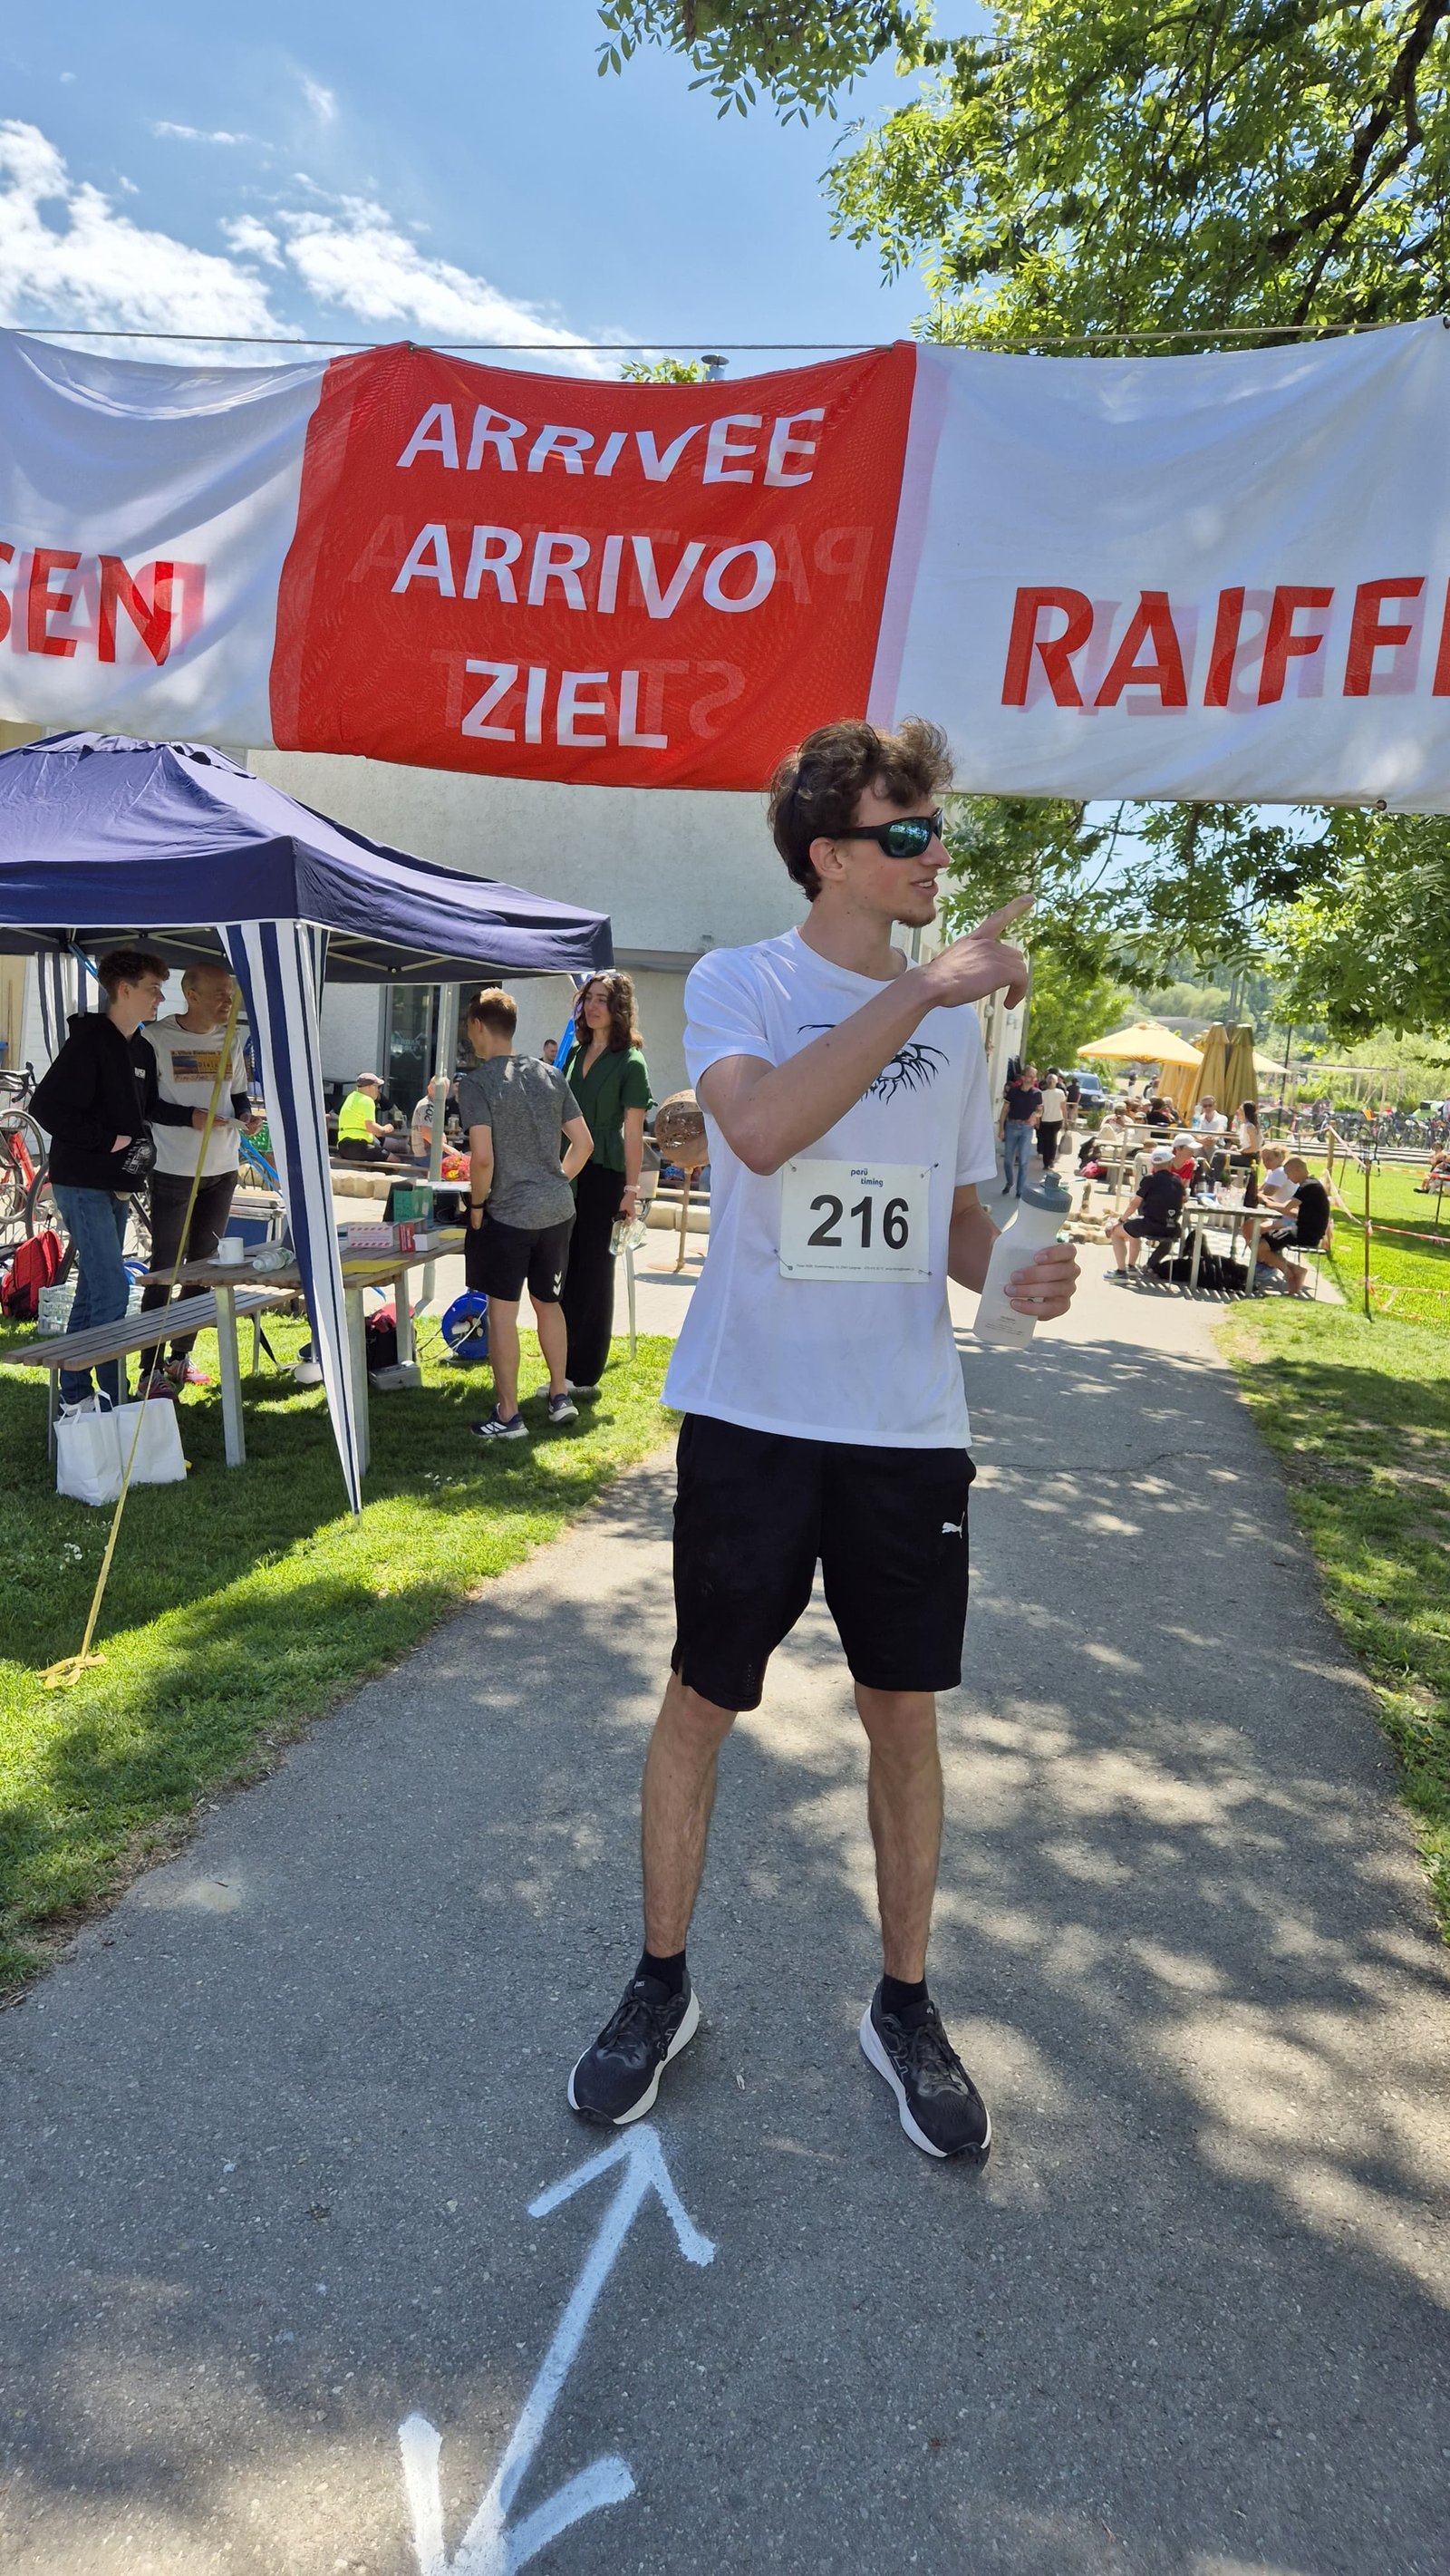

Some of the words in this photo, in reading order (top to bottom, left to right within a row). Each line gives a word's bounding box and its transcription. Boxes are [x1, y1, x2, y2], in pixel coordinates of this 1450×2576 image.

[396, 402, 826, 488] ARRIVEE
[391, 523, 777, 619] ARRIVO
[461, 658, 668, 750] ZIEL
[807, 1194, 909, 1250] 216
[861, 1178, 884, 1187] timing
